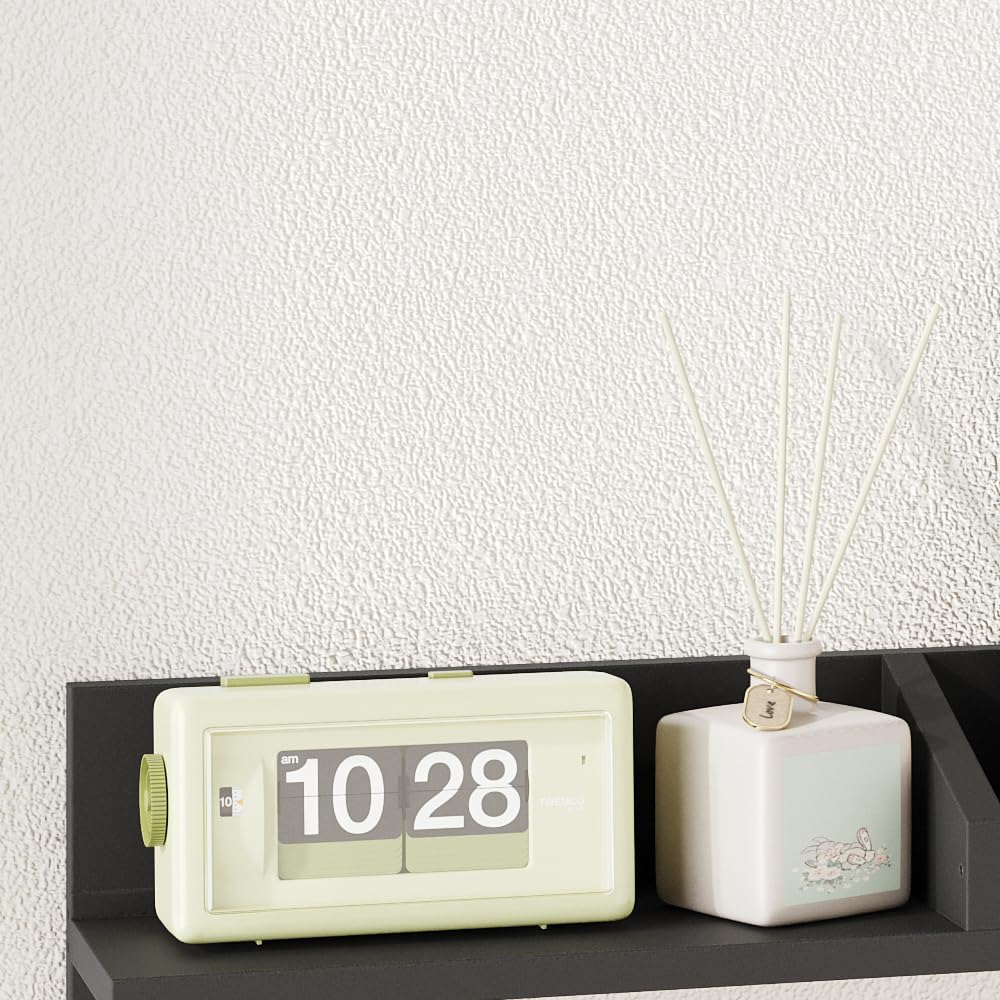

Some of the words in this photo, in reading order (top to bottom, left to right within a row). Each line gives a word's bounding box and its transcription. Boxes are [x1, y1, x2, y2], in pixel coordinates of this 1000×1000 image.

[281, 754, 299, 765] am
[285, 754, 385, 836] 10
[413, 748, 522, 831] 28
[219, 796, 232, 808] 10
